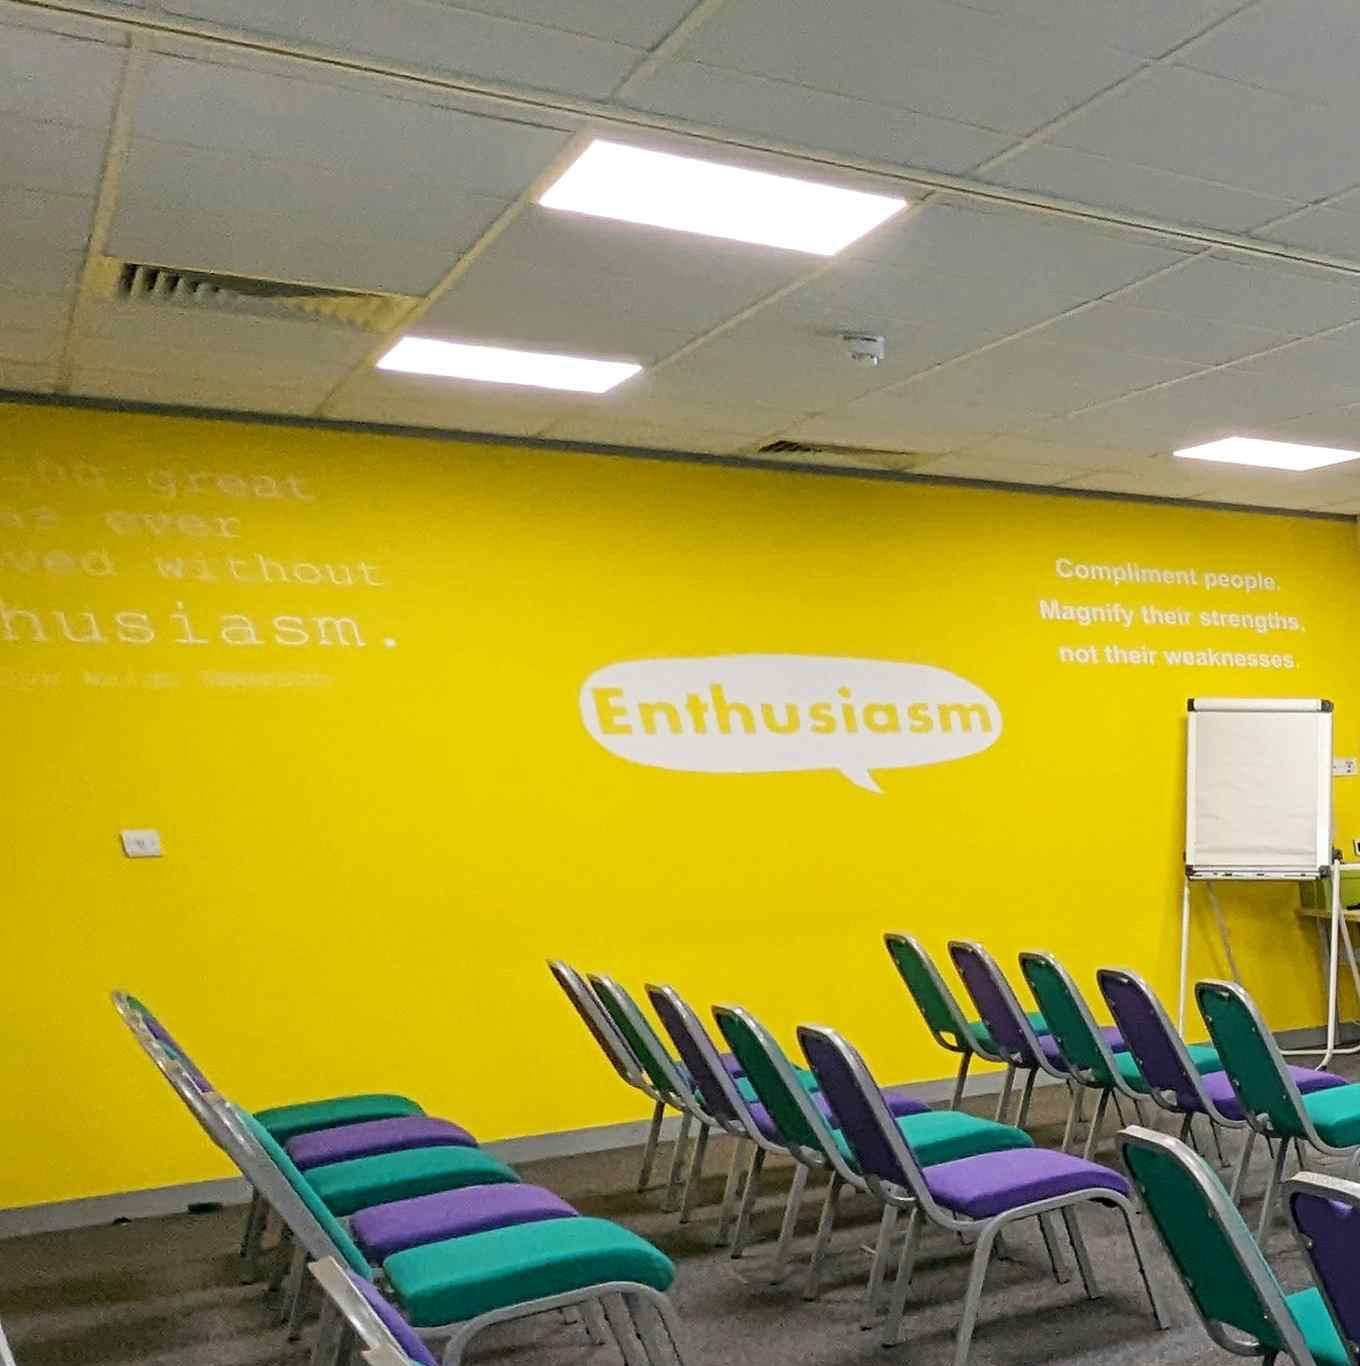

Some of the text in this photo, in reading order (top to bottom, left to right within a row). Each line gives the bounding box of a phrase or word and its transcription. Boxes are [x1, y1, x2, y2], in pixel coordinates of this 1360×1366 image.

[147, 465, 317, 503] great
[103, 509, 243, 541] ever
[152, 548, 388, 590] without
[1055, 557, 1282, 594] Compliment people.
[1039, 599, 1134, 630] Magnify
[1140, 604, 1192, 626] their
[1058, 644, 1301, 671] not their weaknesses.
[591, 682, 994, 737] Enthusiasm
